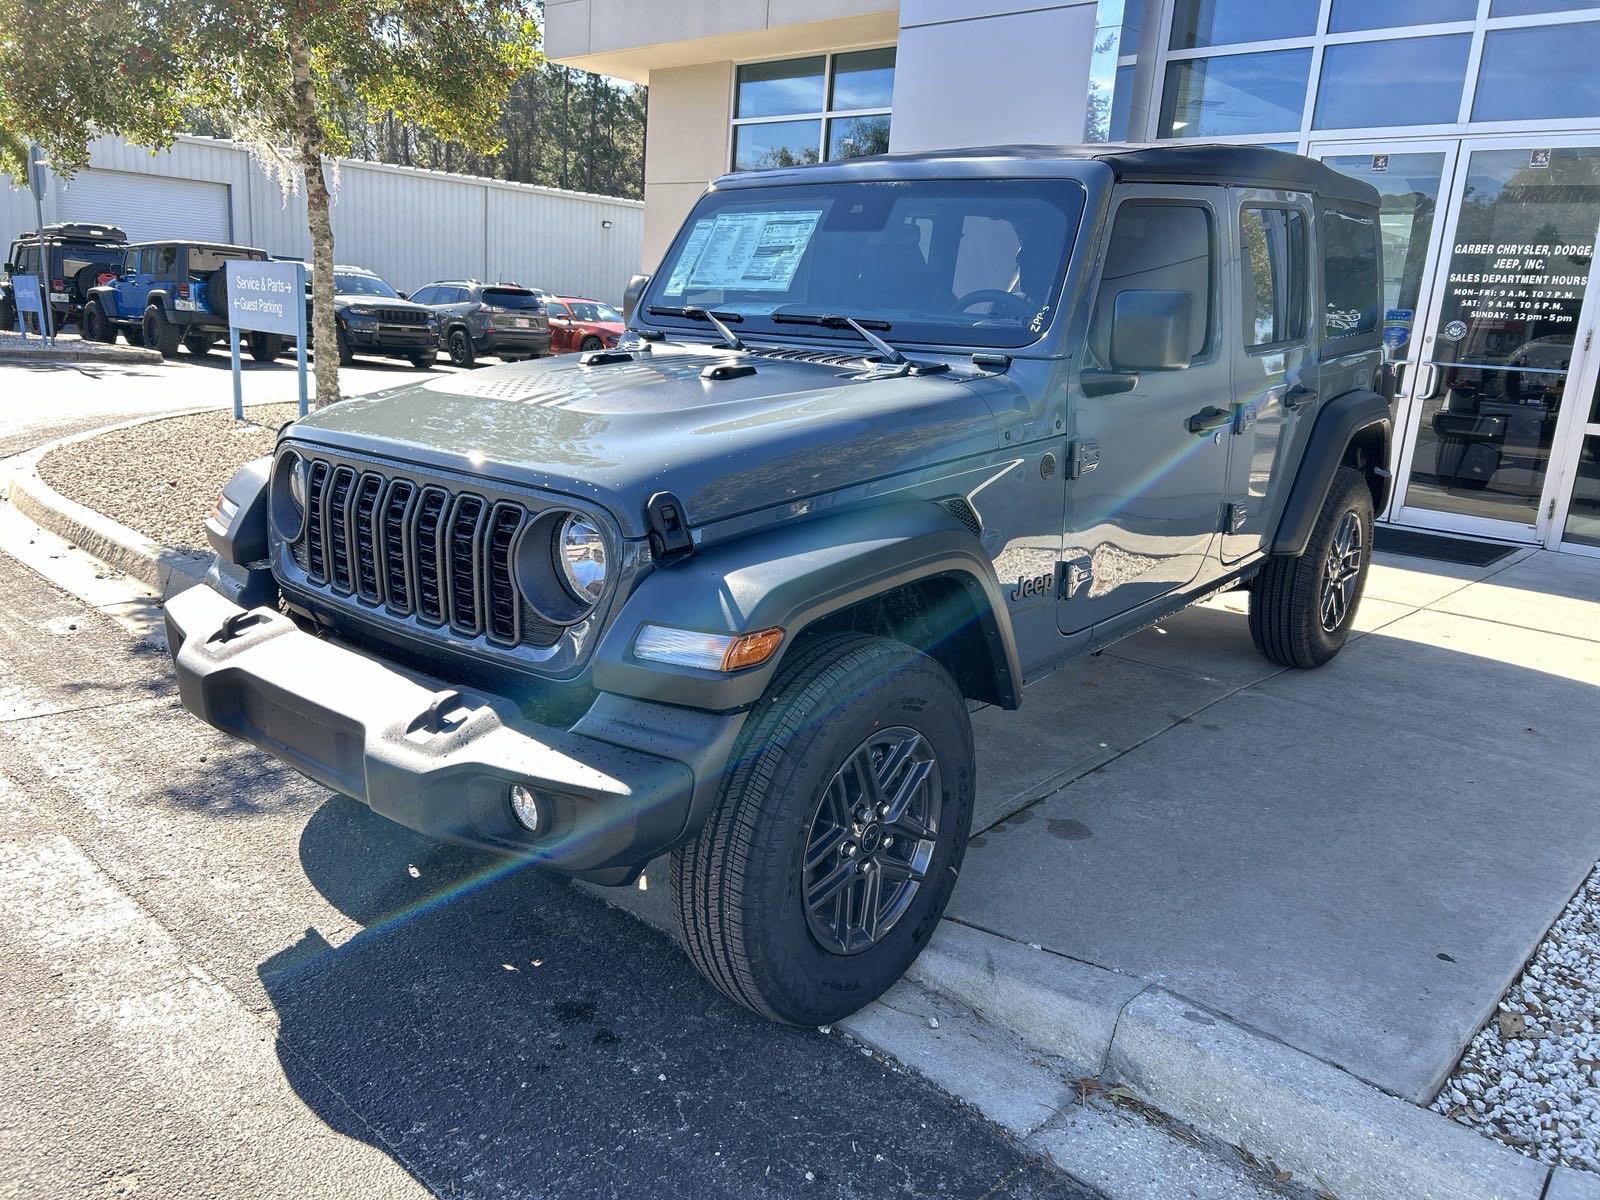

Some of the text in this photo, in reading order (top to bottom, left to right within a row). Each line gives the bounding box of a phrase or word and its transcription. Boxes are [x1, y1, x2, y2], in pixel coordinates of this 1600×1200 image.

[1454, 244, 1594, 258] GARBER CHRYSLER, DODGE,
[1493, 259, 1545, 271] JEEP, INC.
[236, 275, 285, 293] Service & Parts
[1449, 273, 1588, 286] SALES DEPARTMENT HOURS
[1500, 289, 1505, 297] 9
[1507, 289, 1529, 298] A.M.
[1532, 290, 1543, 298] TO
[1554, 291, 1576, 299] P.M.
[240, 296, 283, 318] Guest Parking
[1461, 299, 1564, 310] SAT: 9 A.M. TO 6 P.M.
[1470, 310, 1509, 319] SUNDAY:
[1010, 572, 1054, 601] Jeep
